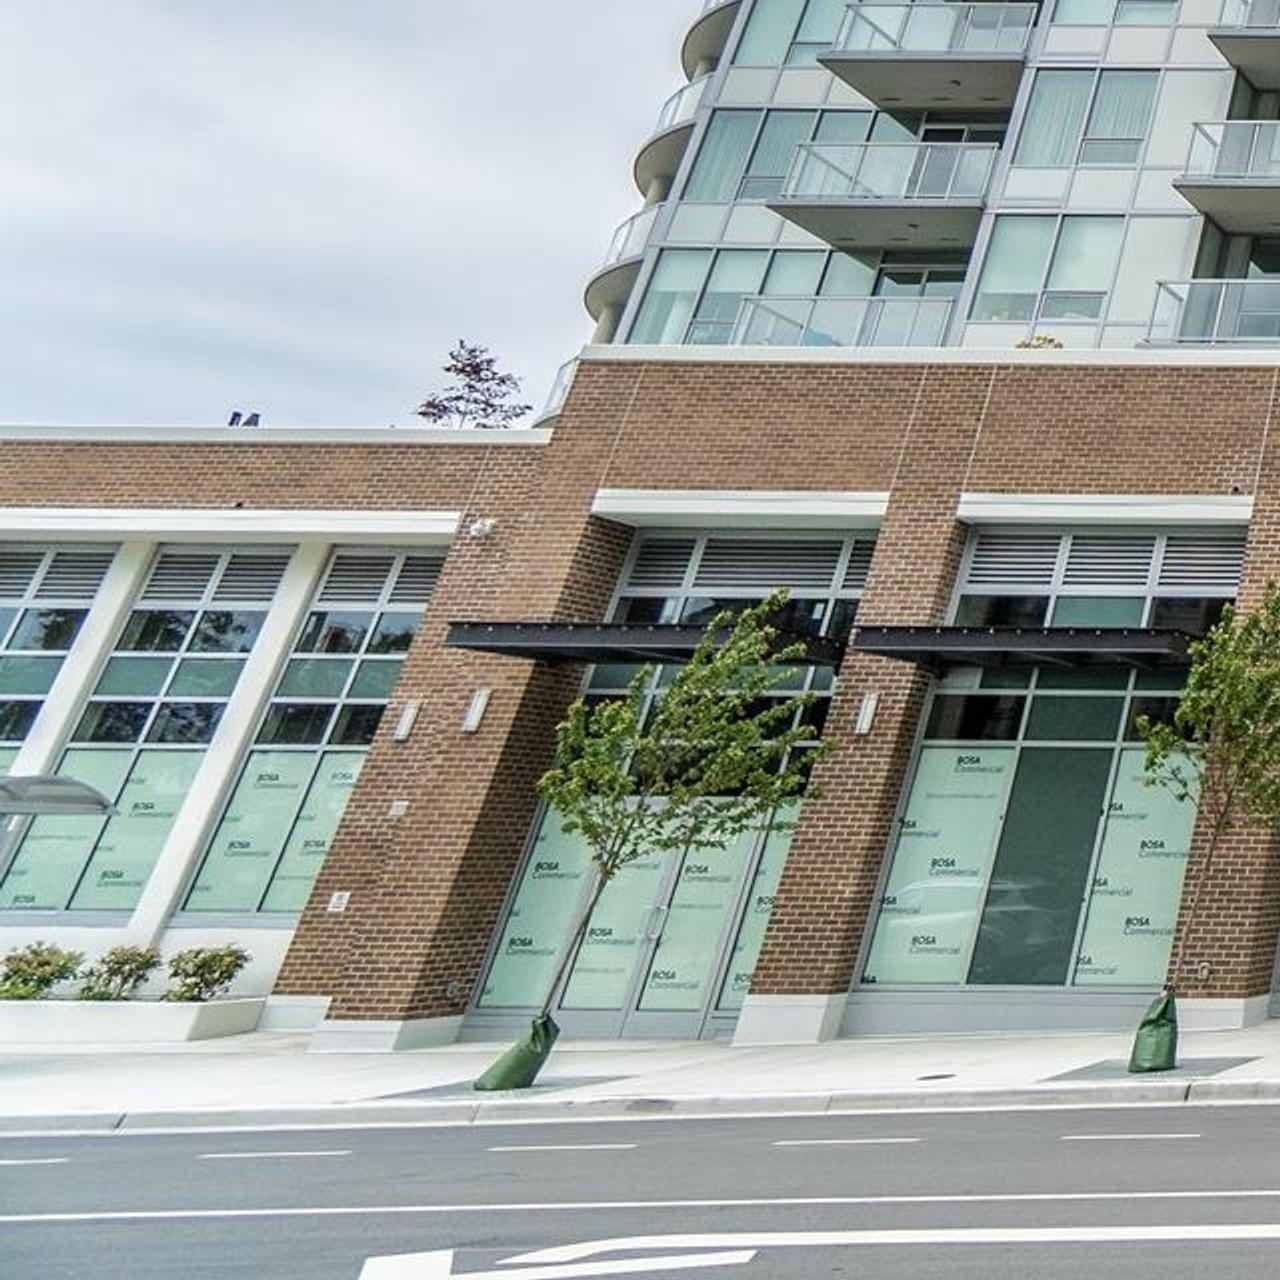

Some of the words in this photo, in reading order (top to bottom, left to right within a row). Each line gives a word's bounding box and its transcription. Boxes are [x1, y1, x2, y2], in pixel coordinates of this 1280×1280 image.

[956, 756, 981, 765] BOSA
[1140, 840, 1165, 850] BOSA
[931, 858, 955, 867] BOSA
[1125, 917, 1150, 926] BOSA
[912, 936, 937, 945] BOSA
